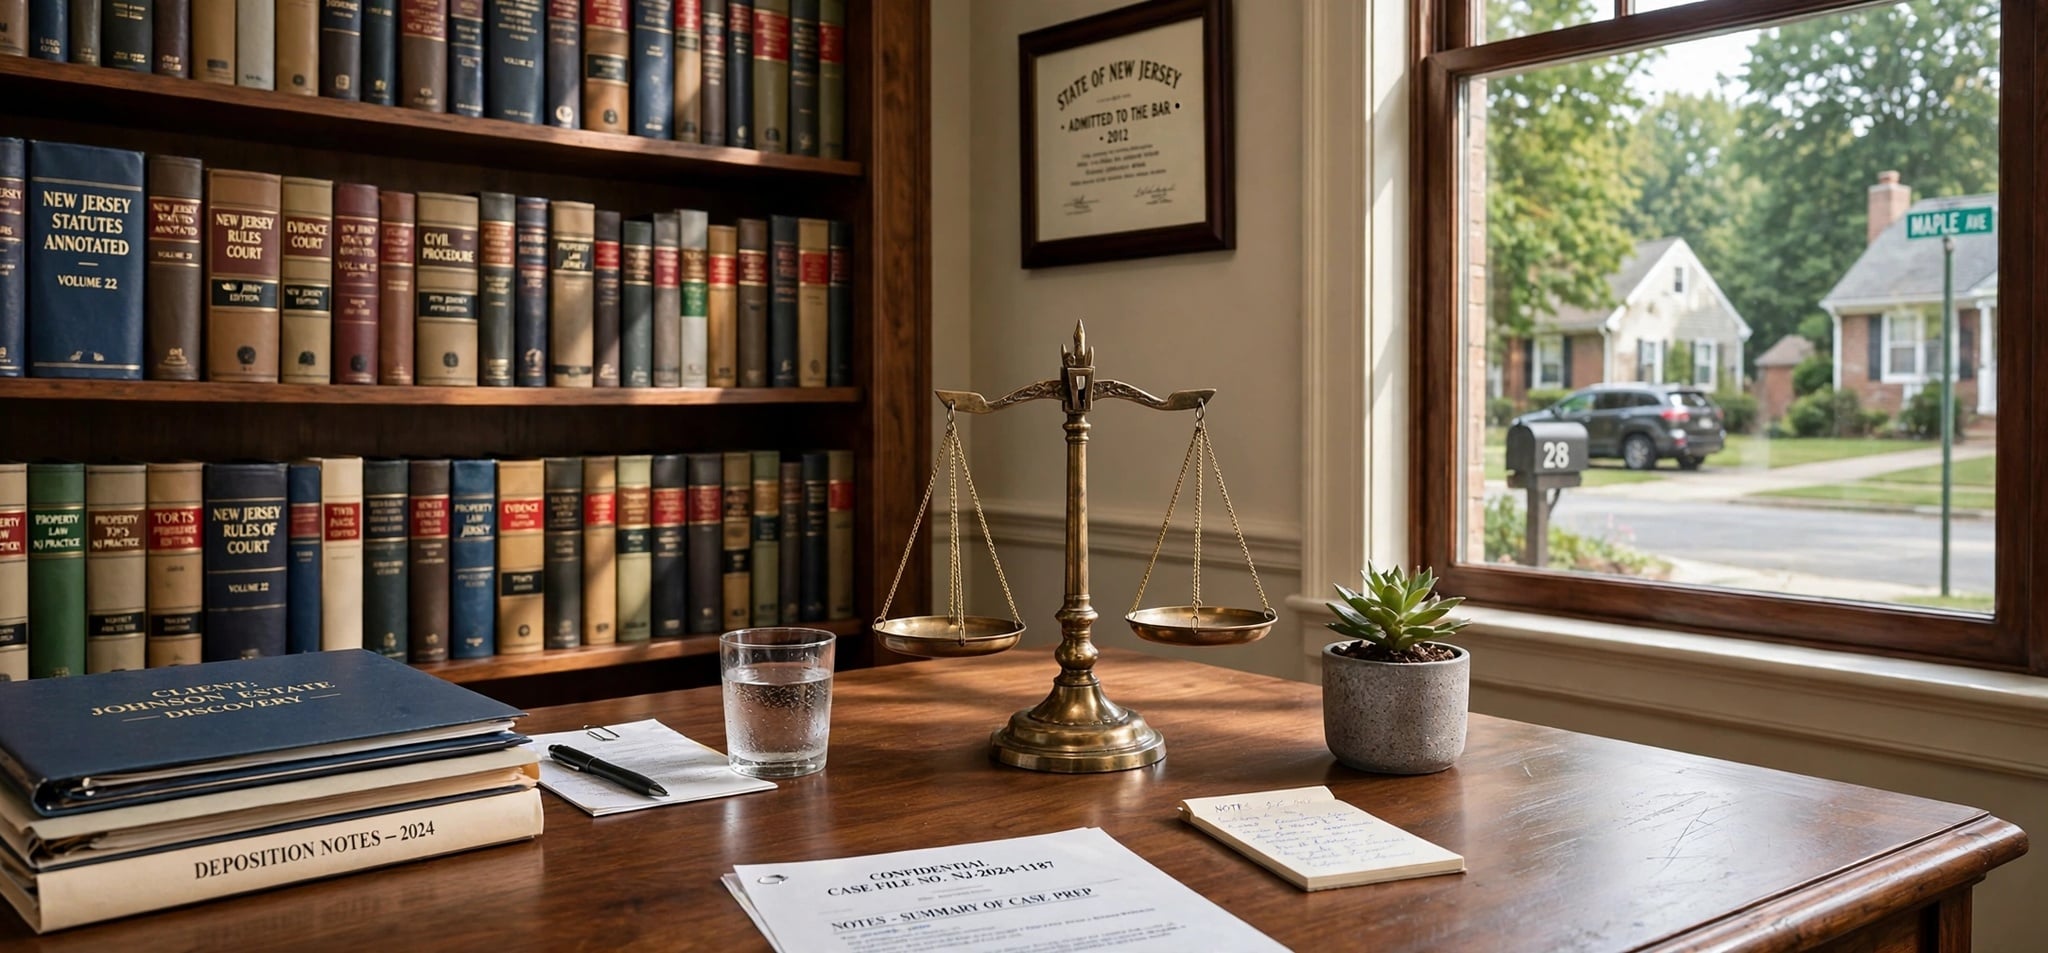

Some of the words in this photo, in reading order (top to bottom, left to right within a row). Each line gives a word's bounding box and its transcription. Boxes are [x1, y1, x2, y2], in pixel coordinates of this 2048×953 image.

[1057, 75, 1088, 111] STATE
[1091, 66, 1105, 88] OF
[1109, 60, 1135, 82] NEW
[1138, 60, 1182, 89] JERSEY
[1068, 113, 1113, 132] ADMITTED
[1116, 109, 1128, 123] TO
[1131, 104, 1148, 121] THE
[1152, 101, 1171, 117] BAR
[1107, 129, 1129, 143] 2012
[43, 190, 77, 209] NEW
[81, 194, 131, 214] JERSEY
[52, 213, 123, 234] STATUTES
[216, 213, 239, 227] NEW
[241, 215, 274, 230] JERSEY
[287, 221, 328, 236] EVIDENCE
[1911, 212, 1960, 235] MAPLE
[1965, 213, 1987, 231] AVE
[228, 229, 261, 244] RULES
[291, 235, 323, 249] COURT
[424, 232, 449, 246] CIVIL
[44, 234, 130, 256] ANNOTATED
[226, 245, 262, 260] COURT
[422, 248, 474, 263] PROCEDURE
[57, 275, 102, 288] VOLUME
[104, 278, 118, 290] 22
[1543, 441, 1570, 469] 28
[35, 514, 79, 525] PROPERTY
[95, 514, 139, 525] PROPERTY
[154, 511, 195, 524] TORTS
[212, 508, 240, 521] NEW
[242, 506, 281, 522] JERSEY
[48, 527, 68, 536] LAW
[223, 523, 260, 537] RULES
[261, 522, 278, 536] OF
[45, 538, 80, 548] PRACTICE
[104, 538, 140, 548] PRACTICE
[227, 540, 270, 554] COURT
[152, 681, 258, 698] CLIENT:
[91, 692, 226, 716] JOHNSON
[236, 681, 336, 699] ESTATE
[164, 695, 303, 719] DISCOVERY
[194, 841, 315, 880] DEPOSITION
[320, 830, 381, 856] NOTES
[401, 820, 436, 842] 2024
[827, 883, 873, 896] CASE
[875, 879, 915, 891] FILE
[917, 875, 948, 885] NO.
[831, 916, 887, 931] NOTES
[899, 903, 979, 921] SUMMARY
[983, 899, 1003, 909] OF
[1053, 887, 1092, 900] PREP
